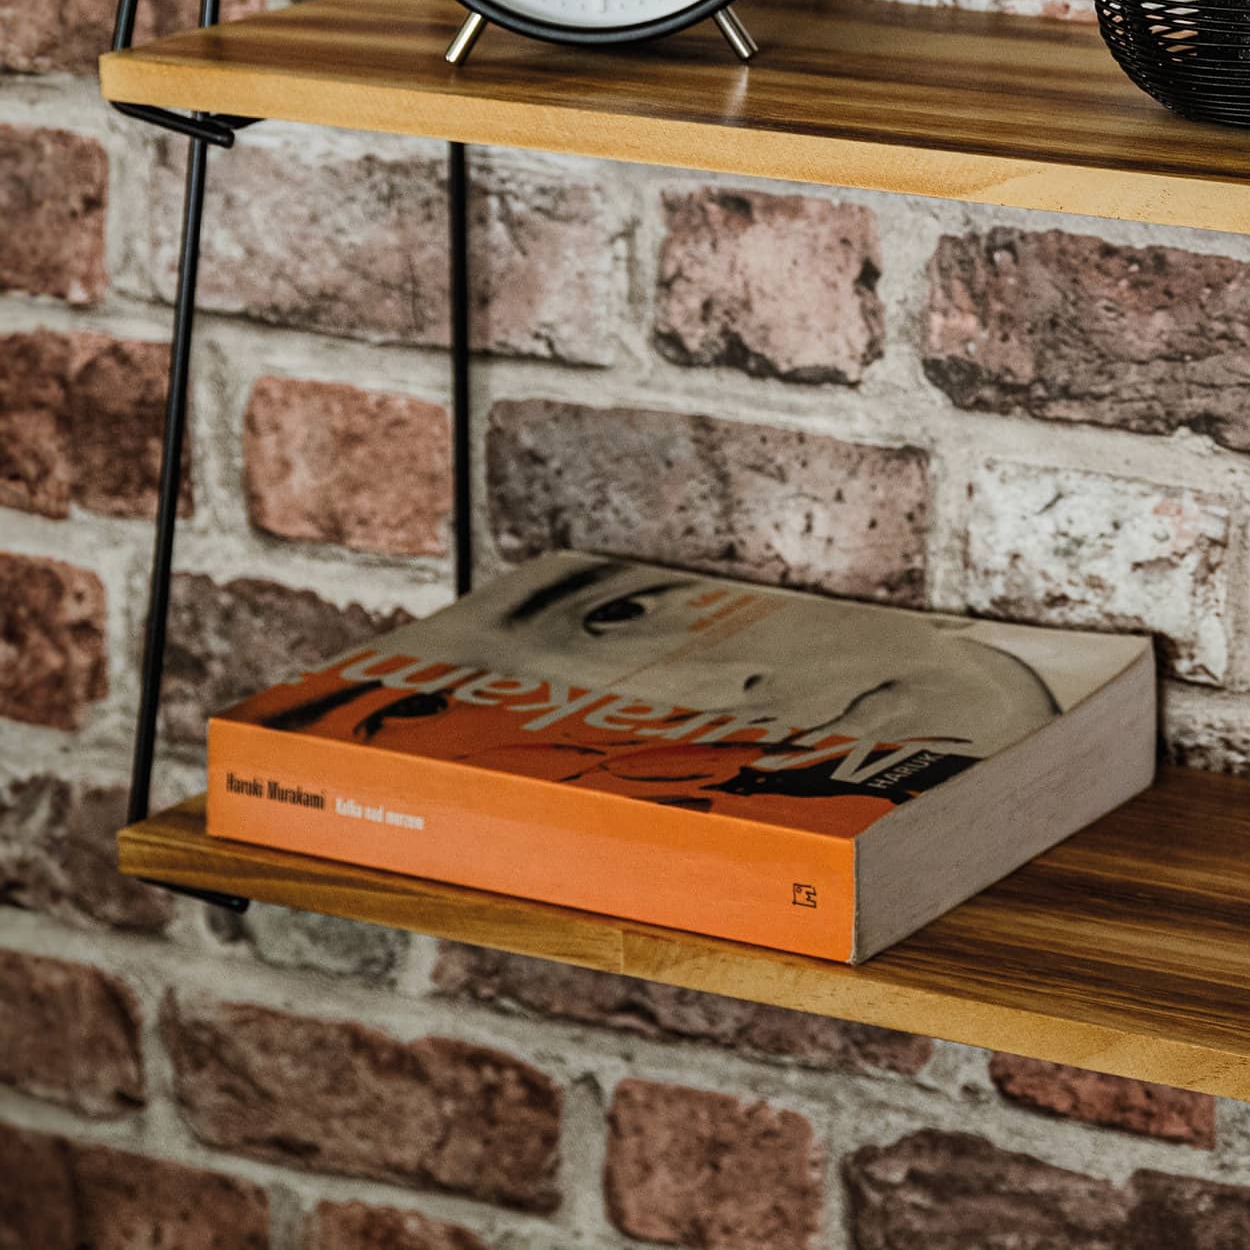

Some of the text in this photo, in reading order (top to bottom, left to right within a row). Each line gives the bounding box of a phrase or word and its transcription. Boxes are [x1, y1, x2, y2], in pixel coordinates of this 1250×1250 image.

[284, 648, 926, 785] Murakami
[226, 771, 325, 810] Haruki Murakami
